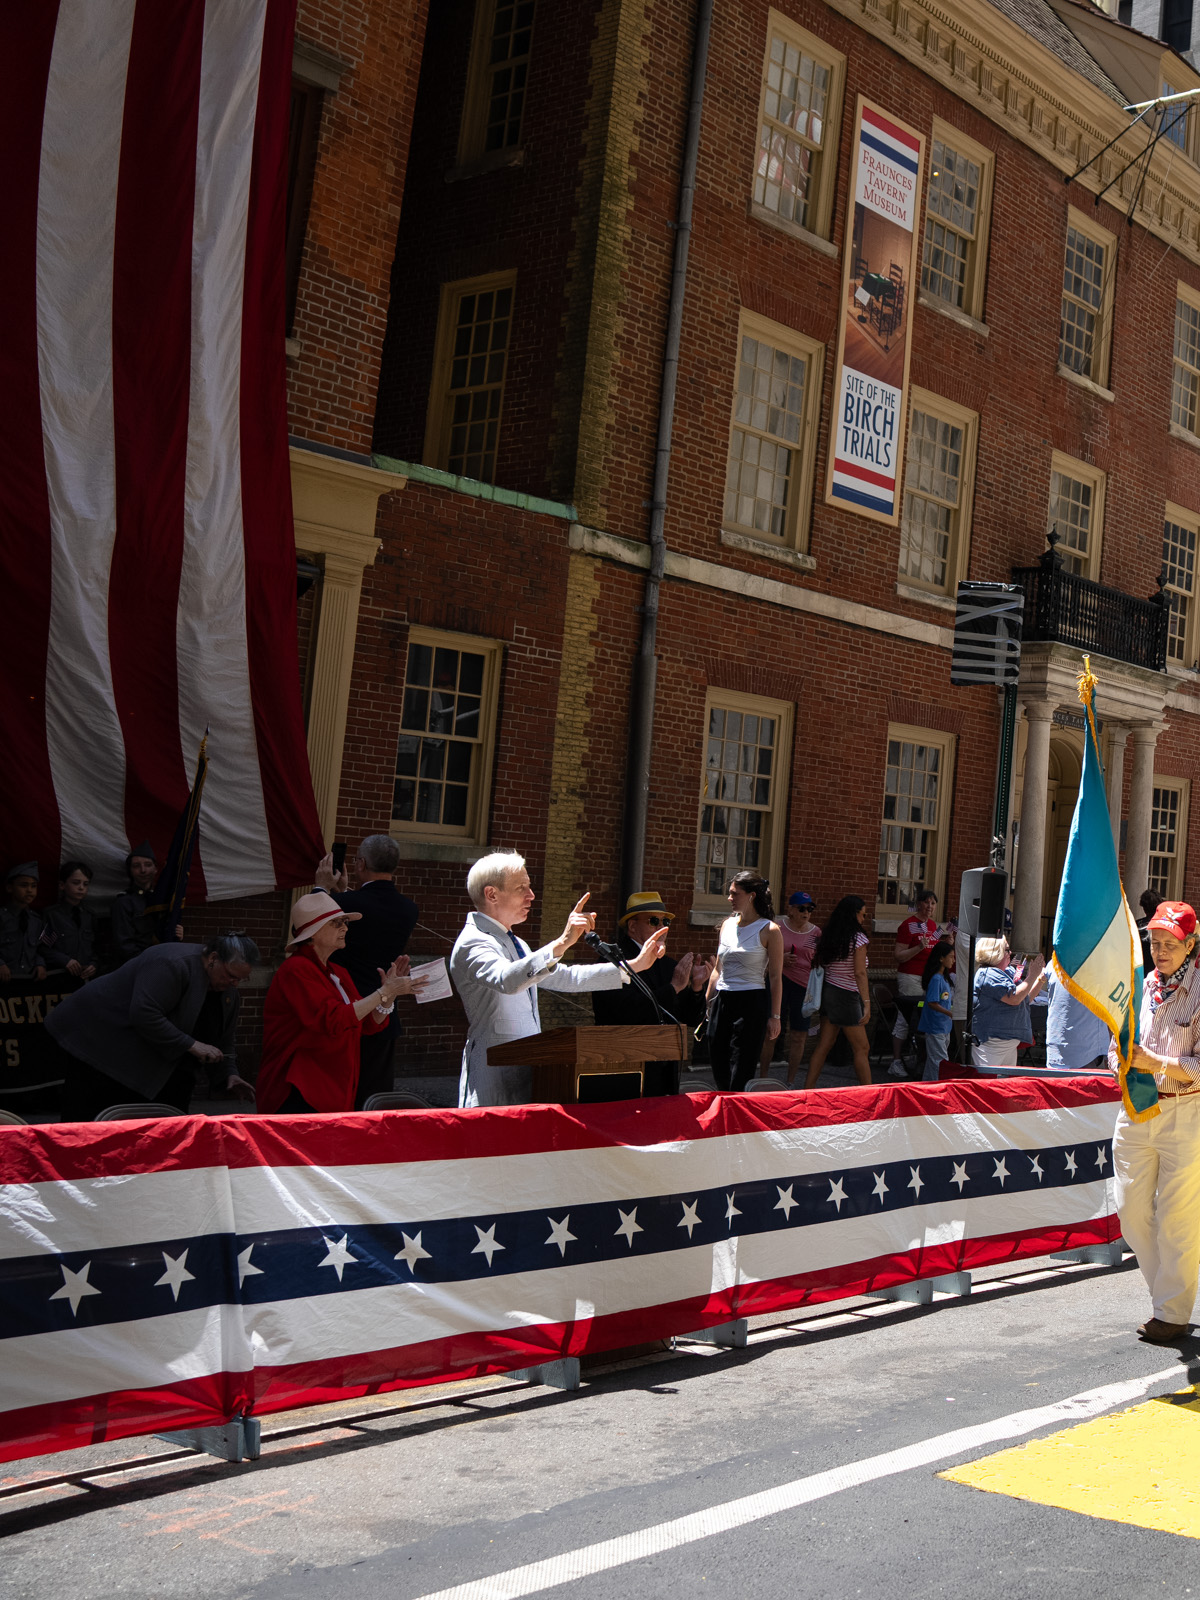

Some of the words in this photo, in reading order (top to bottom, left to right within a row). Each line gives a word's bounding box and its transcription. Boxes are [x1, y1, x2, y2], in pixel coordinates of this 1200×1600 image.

[862, 149, 912, 191] FRAUNCES
[863, 184, 907, 221] MUSEUM
[846, 374, 864, 396] SITE
[866, 383, 878, 400] OF
[880, 388, 896, 409] THE
[843, 391, 895, 441] BIRCH
[843, 425, 891, 468] TRIALS
